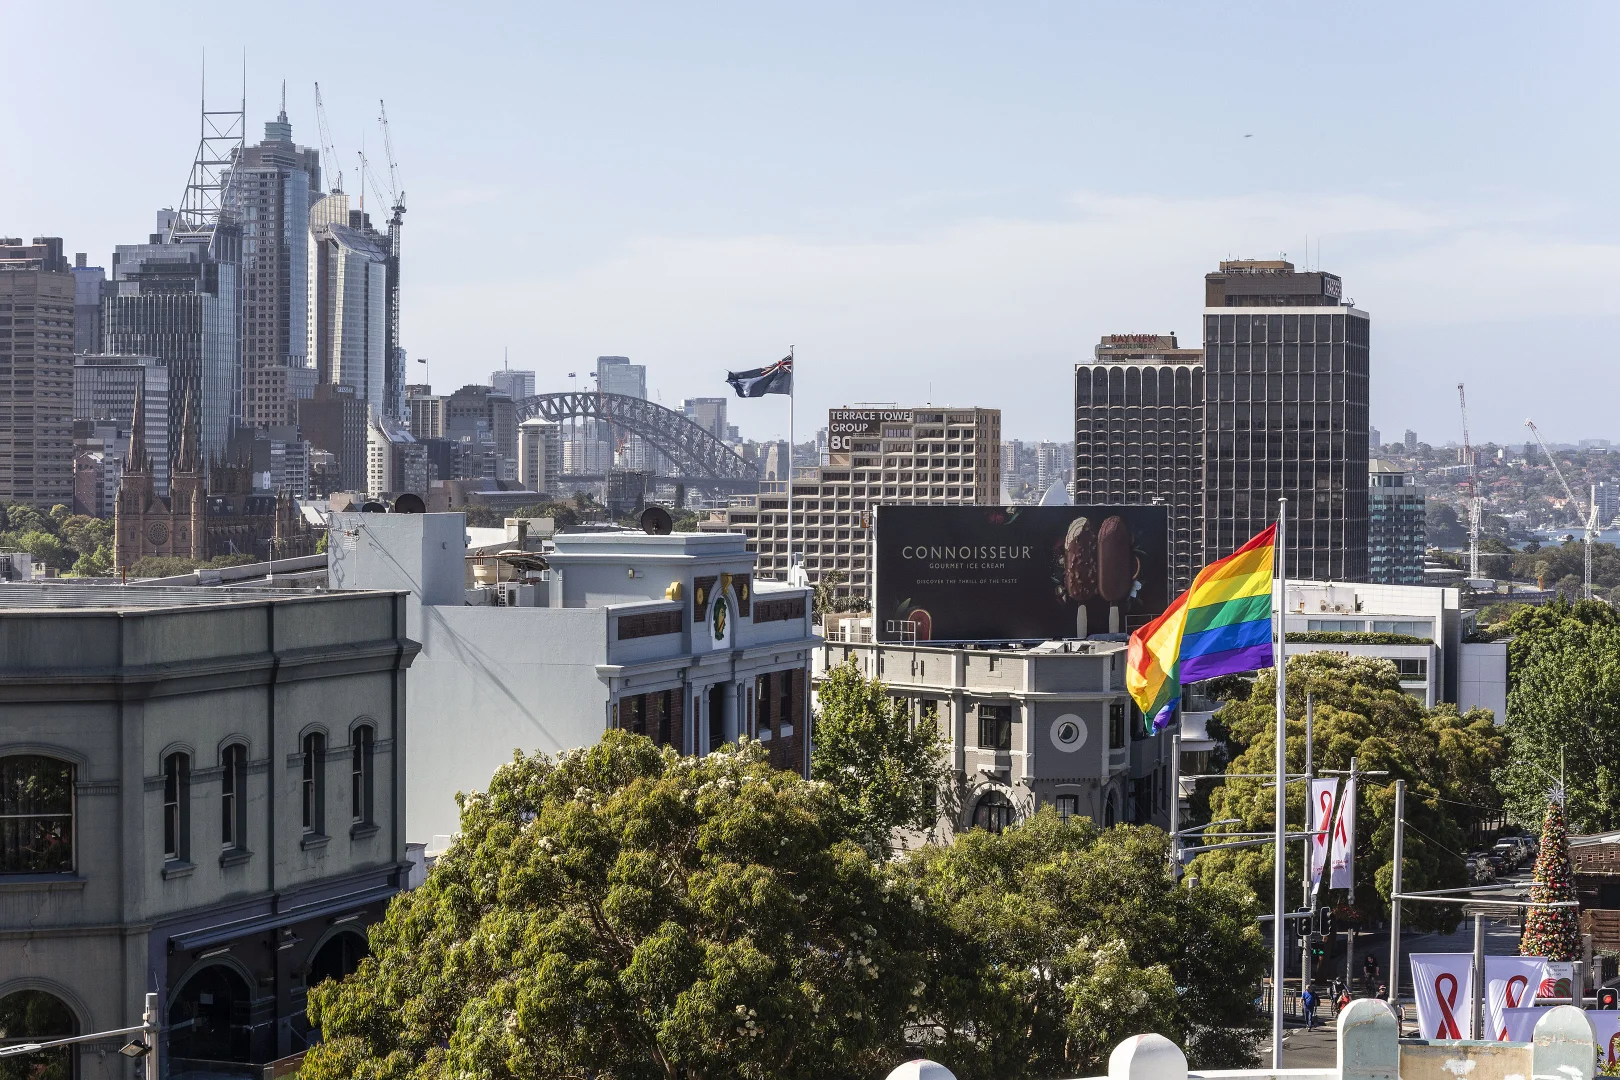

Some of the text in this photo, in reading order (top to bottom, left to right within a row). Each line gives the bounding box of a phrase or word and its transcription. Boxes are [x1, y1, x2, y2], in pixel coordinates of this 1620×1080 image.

[1110, 334, 1157, 343] BAYVIEW
[831, 411, 876, 420] TERRACE
[831, 423, 869, 432] GROUP
[902, 546, 1031, 559] CONNOISSEUR
